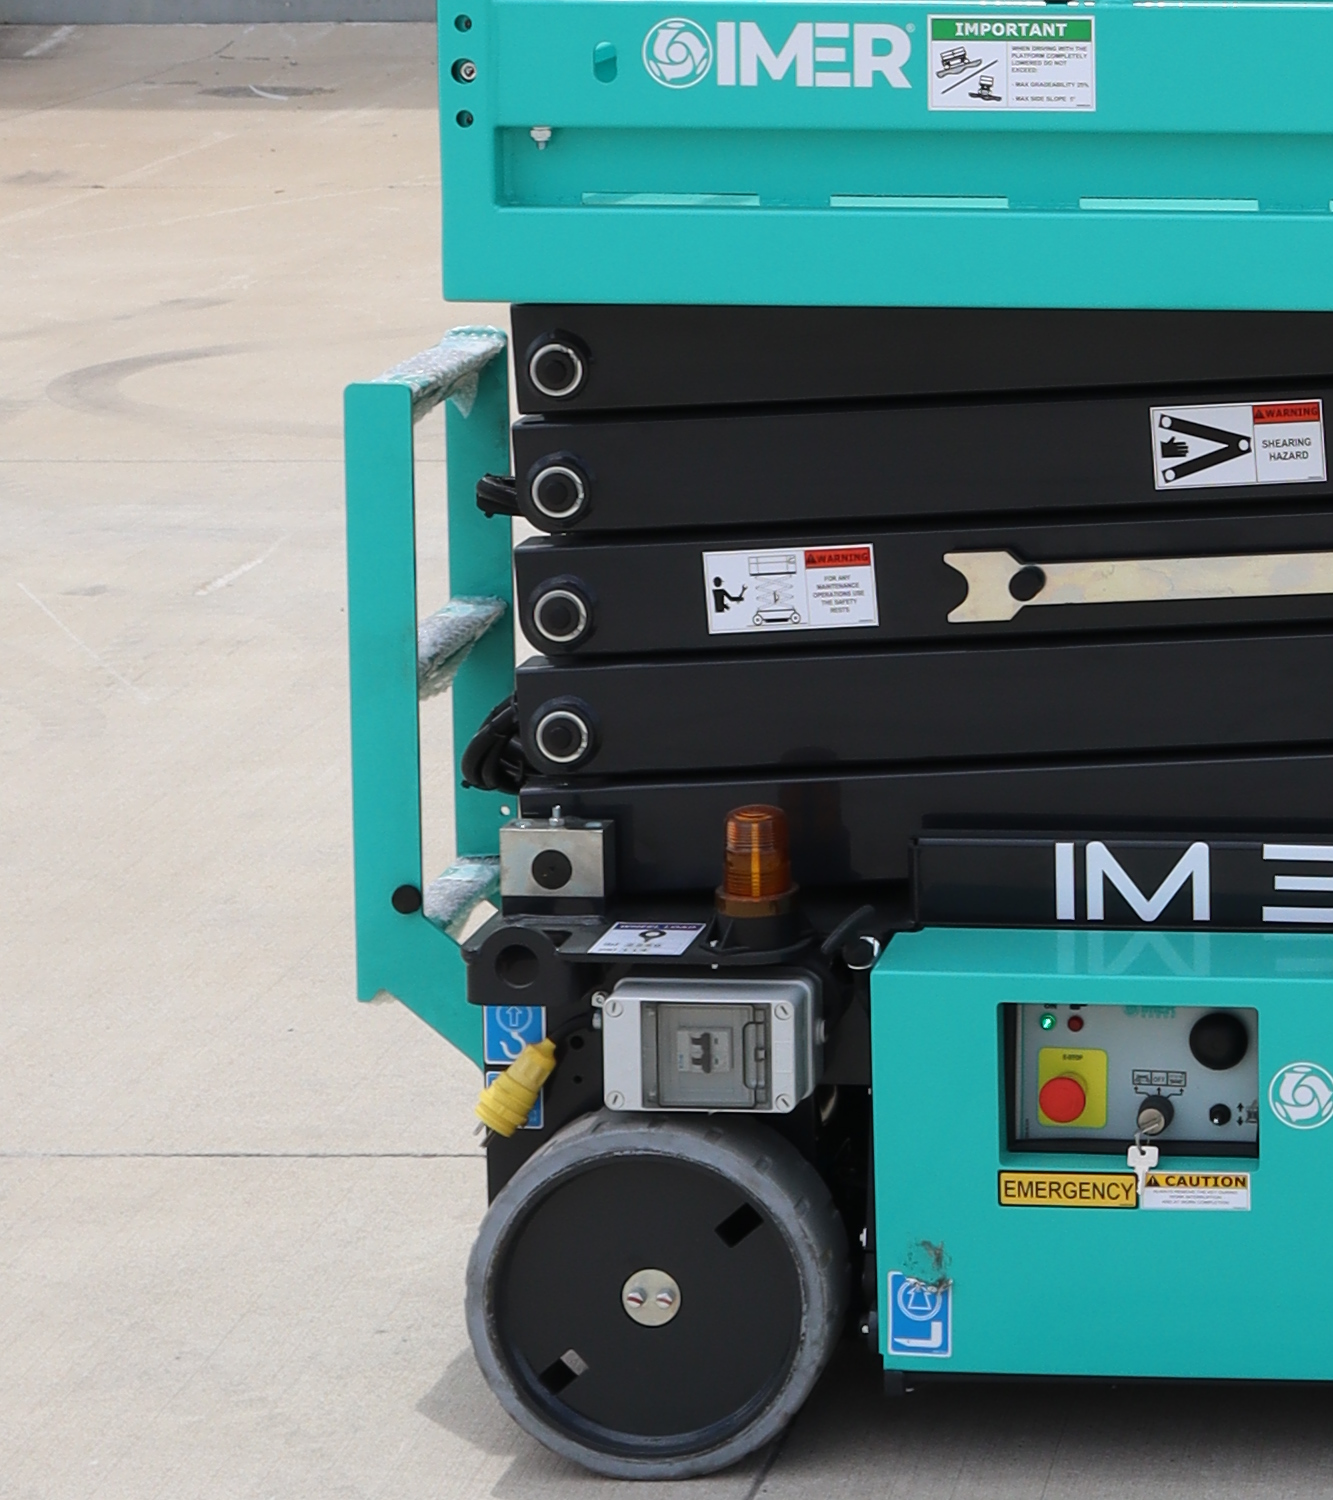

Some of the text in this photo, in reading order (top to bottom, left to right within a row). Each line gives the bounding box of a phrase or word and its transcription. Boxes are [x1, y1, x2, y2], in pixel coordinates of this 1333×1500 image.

[955, 22, 1067, 36] IMPORTANT
[717, 21, 912, 88] IMER
[1265, 407, 1318, 418] WARNING
[1261, 438, 1311, 449] SHEARING
[1269, 451, 1309, 461] HAZARD
[818, 553, 868, 563] WARNING
[1054, 841, 1210, 922] IM
[1165, 1175, 1246, 1187] CAUTION
[1003, 1180, 1134, 1200] EMERGENCY
